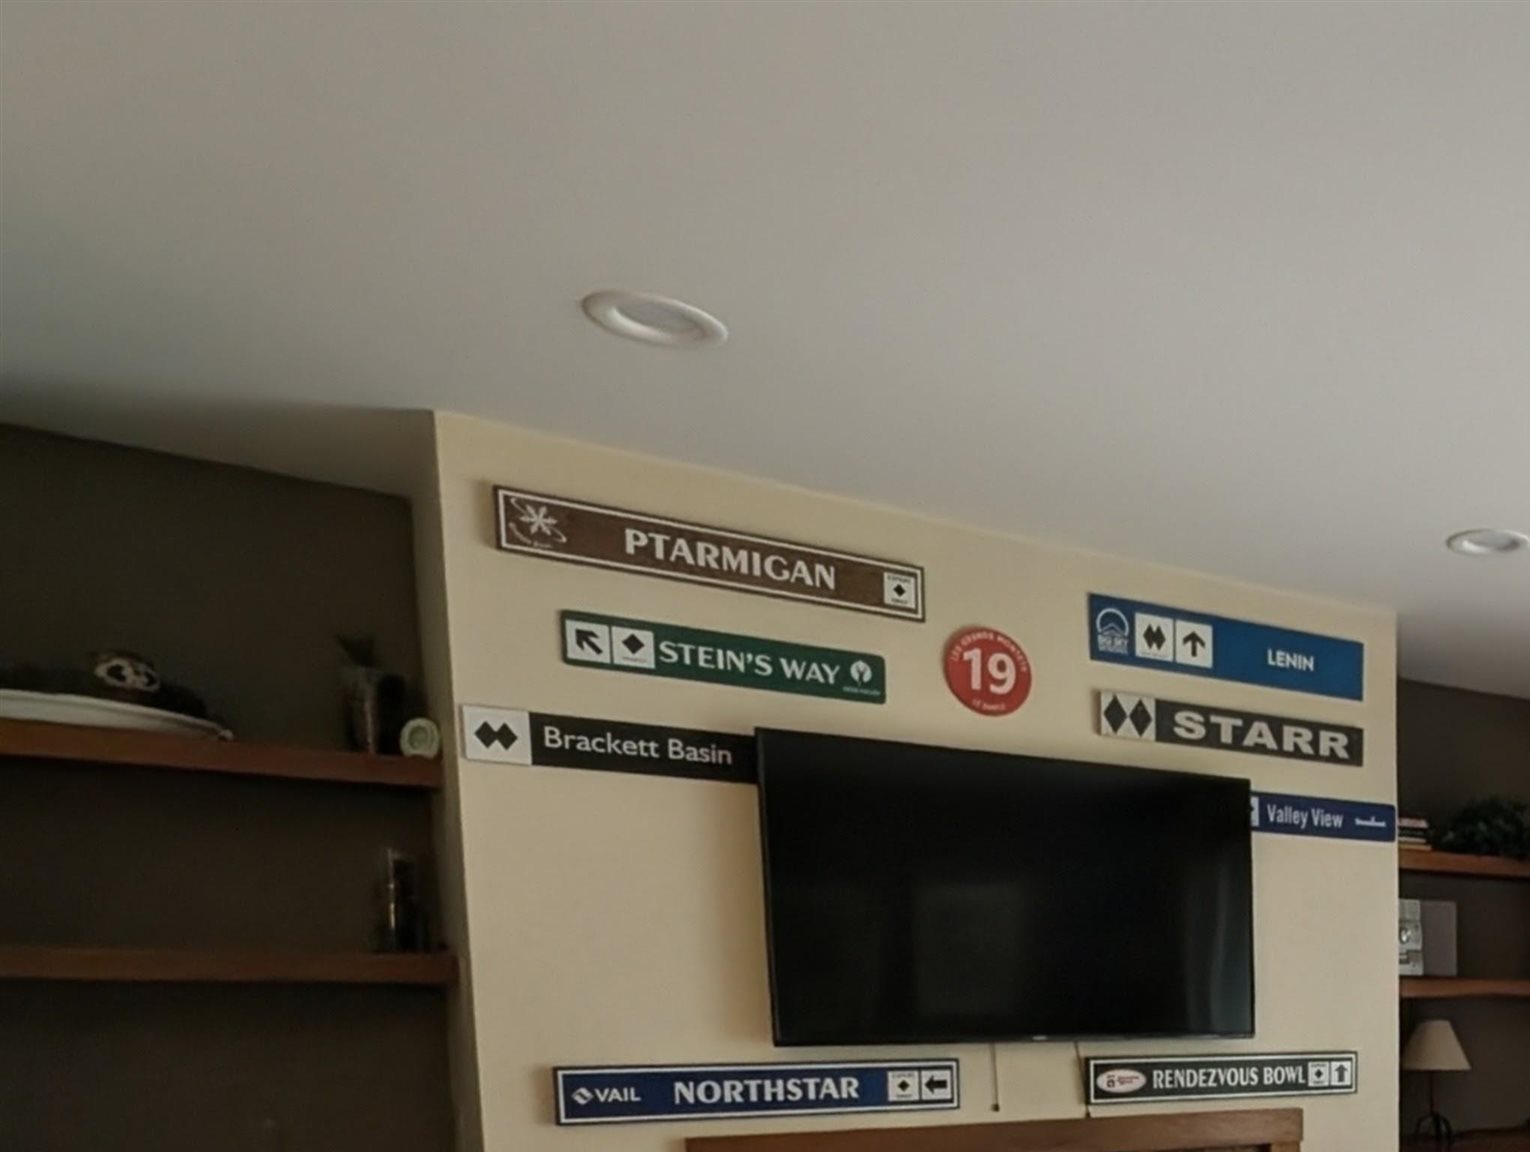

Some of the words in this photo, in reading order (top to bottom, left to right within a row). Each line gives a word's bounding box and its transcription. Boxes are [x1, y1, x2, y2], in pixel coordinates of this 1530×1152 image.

[624, 527, 836, 590] PTARMIGAN
[658, 640, 774, 677] STEIN'S
[779, 657, 840, 685] WAY
[962, 647, 1017, 695] 19
[1266, 647, 1315, 672] LENIN
[543, 725, 661, 759] Brackett
[667, 737, 733, 765] Basin
[1172, 710, 1350, 759] STARR
[1266, 803, 1309, 830] Valley
[1310, 807, 1345, 829] View
[673, 1076, 860, 1105] NORTHSTAR
[1152, 1066, 1260, 1089] RENDEZVOUS
[1262, 1064, 1307, 1085] BOWL
[594, 1086, 642, 1103] VAIL
